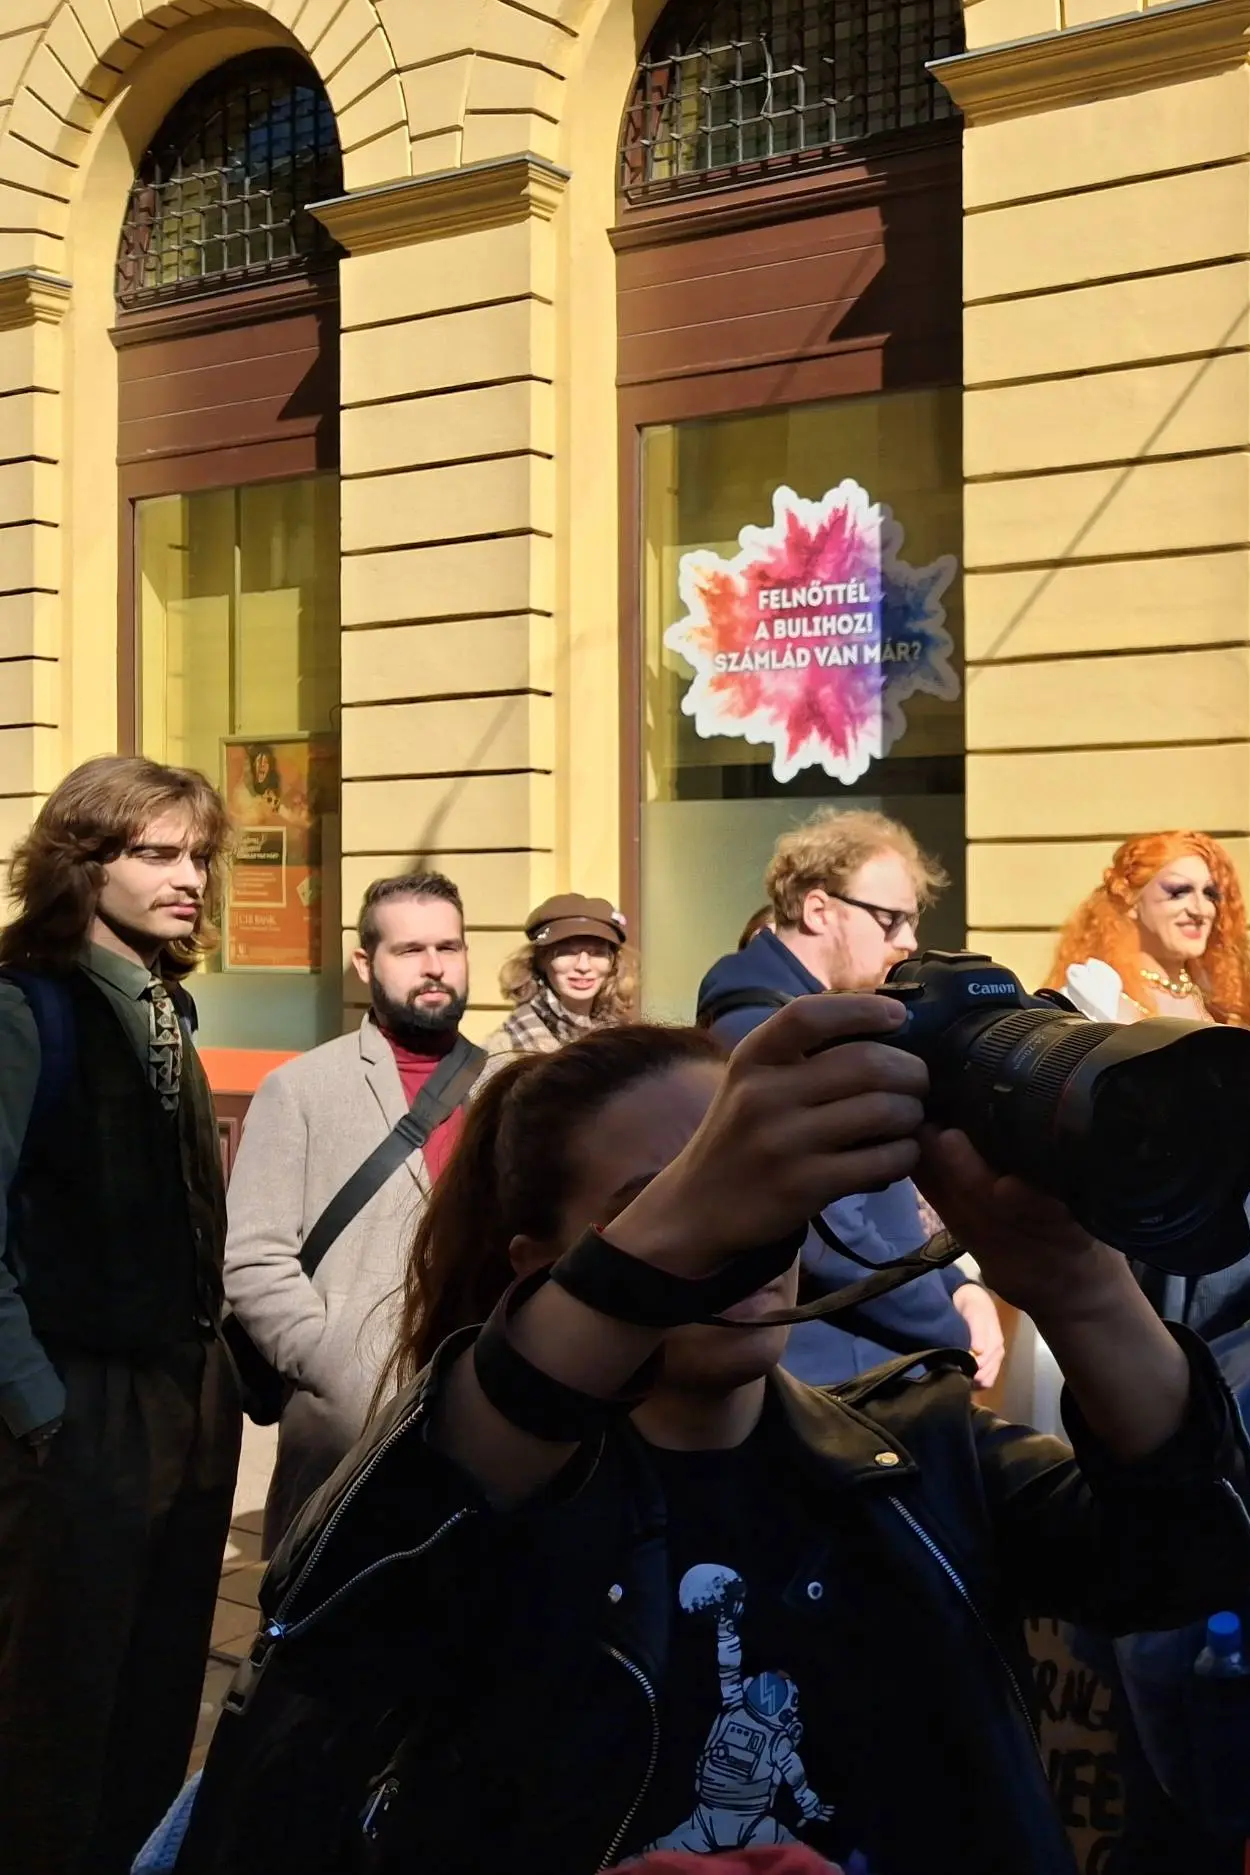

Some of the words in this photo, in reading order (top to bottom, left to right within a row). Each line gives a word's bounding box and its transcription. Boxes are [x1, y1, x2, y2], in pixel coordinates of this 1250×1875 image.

[758, 578, 870, 610] FELNŐTTÉL
[754, 623, 771, 642] A
[774, 613, 873, 638] BULIHOZ!
[713, 645, 811, 673] SZÁMLÁD
[814, 645, 859, 667] VAN
[862, 639, 923, 665] MÁR?
[968, 983, 1016, 995] Canon
